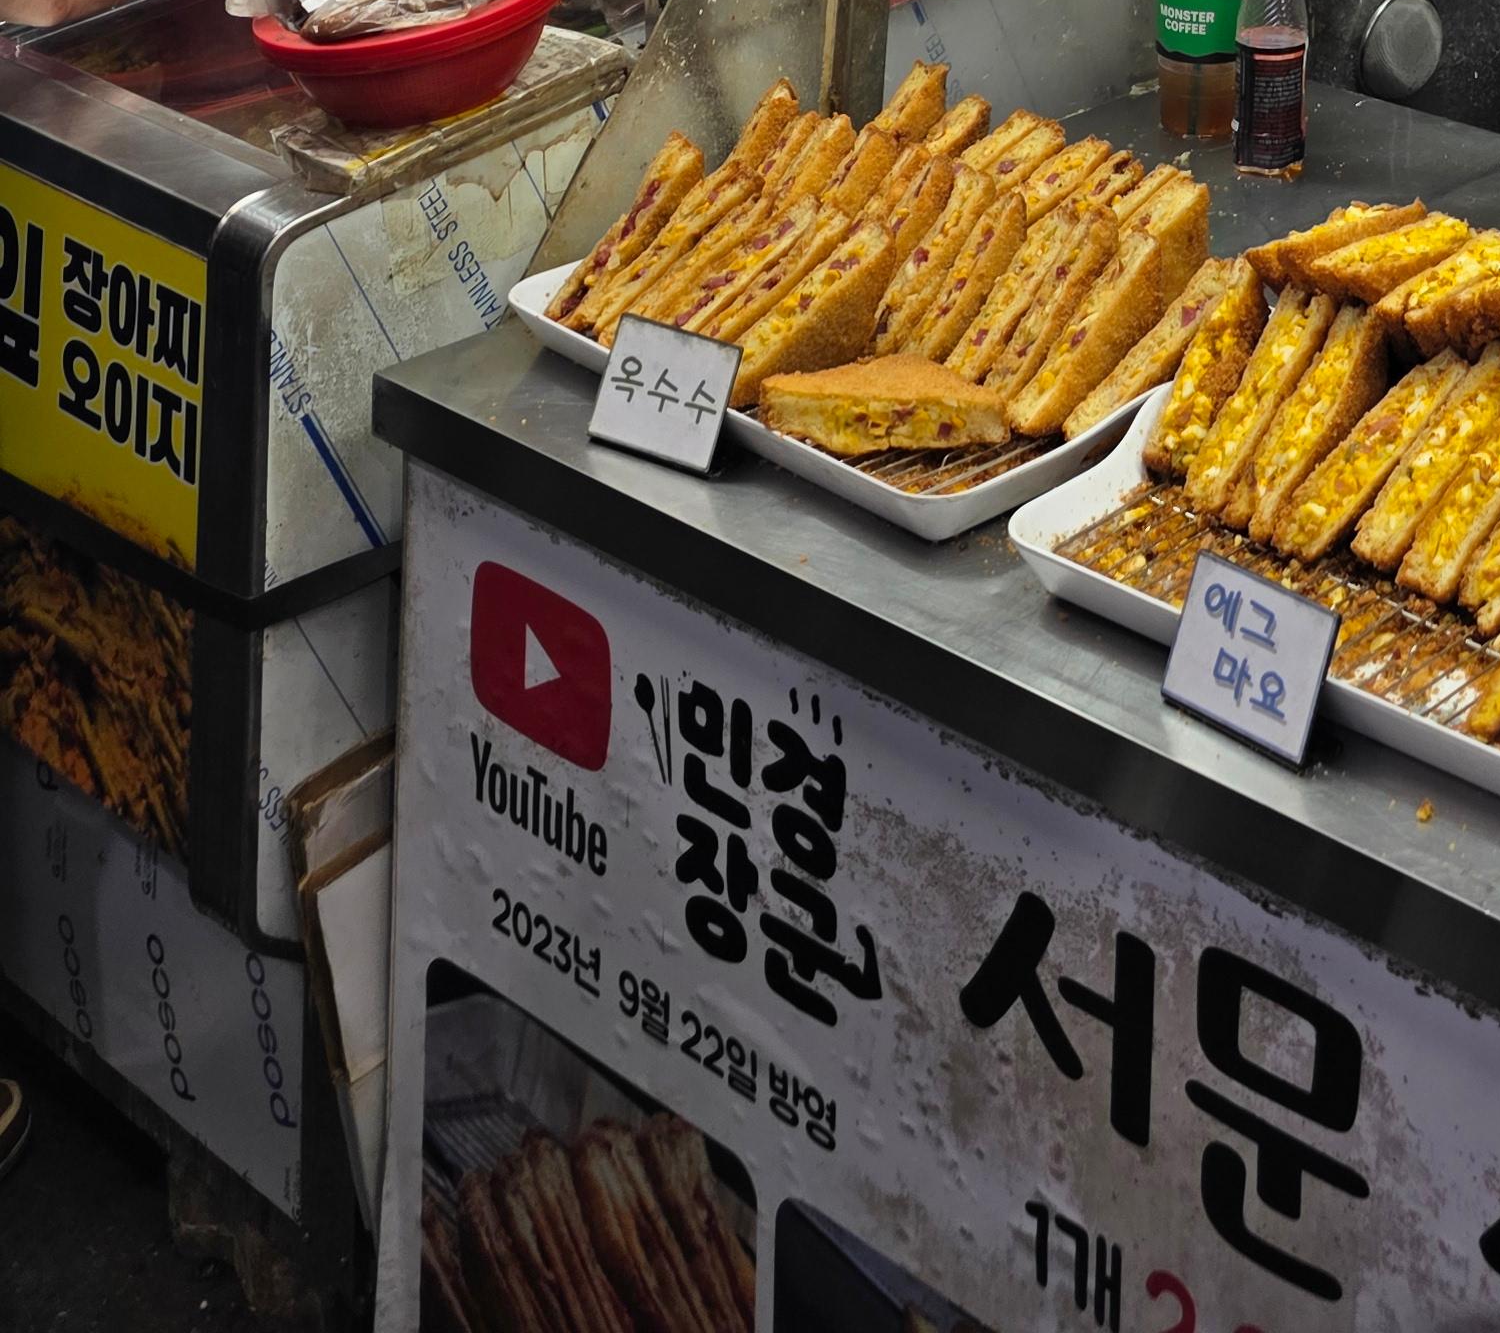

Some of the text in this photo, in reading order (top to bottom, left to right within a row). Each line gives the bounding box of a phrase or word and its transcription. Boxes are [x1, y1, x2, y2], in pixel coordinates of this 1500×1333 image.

[1160, 4, 1215, 24] MONSTER
[1164, 19, 1207, 36] COFFEE
[63, 236, 202, 385] 장아찌
[448, 241, 502, 331] TAINLESS
[59, 339, 198, 485] 오이지
[611, 356, 717, 424] 옥수수
[1204, 583, 1276, 647] 에그
[1213, 647, 1285, 718] 마요
[470, 732, 608, 877] YouTube
[491, 889, 837, 1151] 2023년 9월 22일 방영
[959, 891, 1370, 1301] 서문
